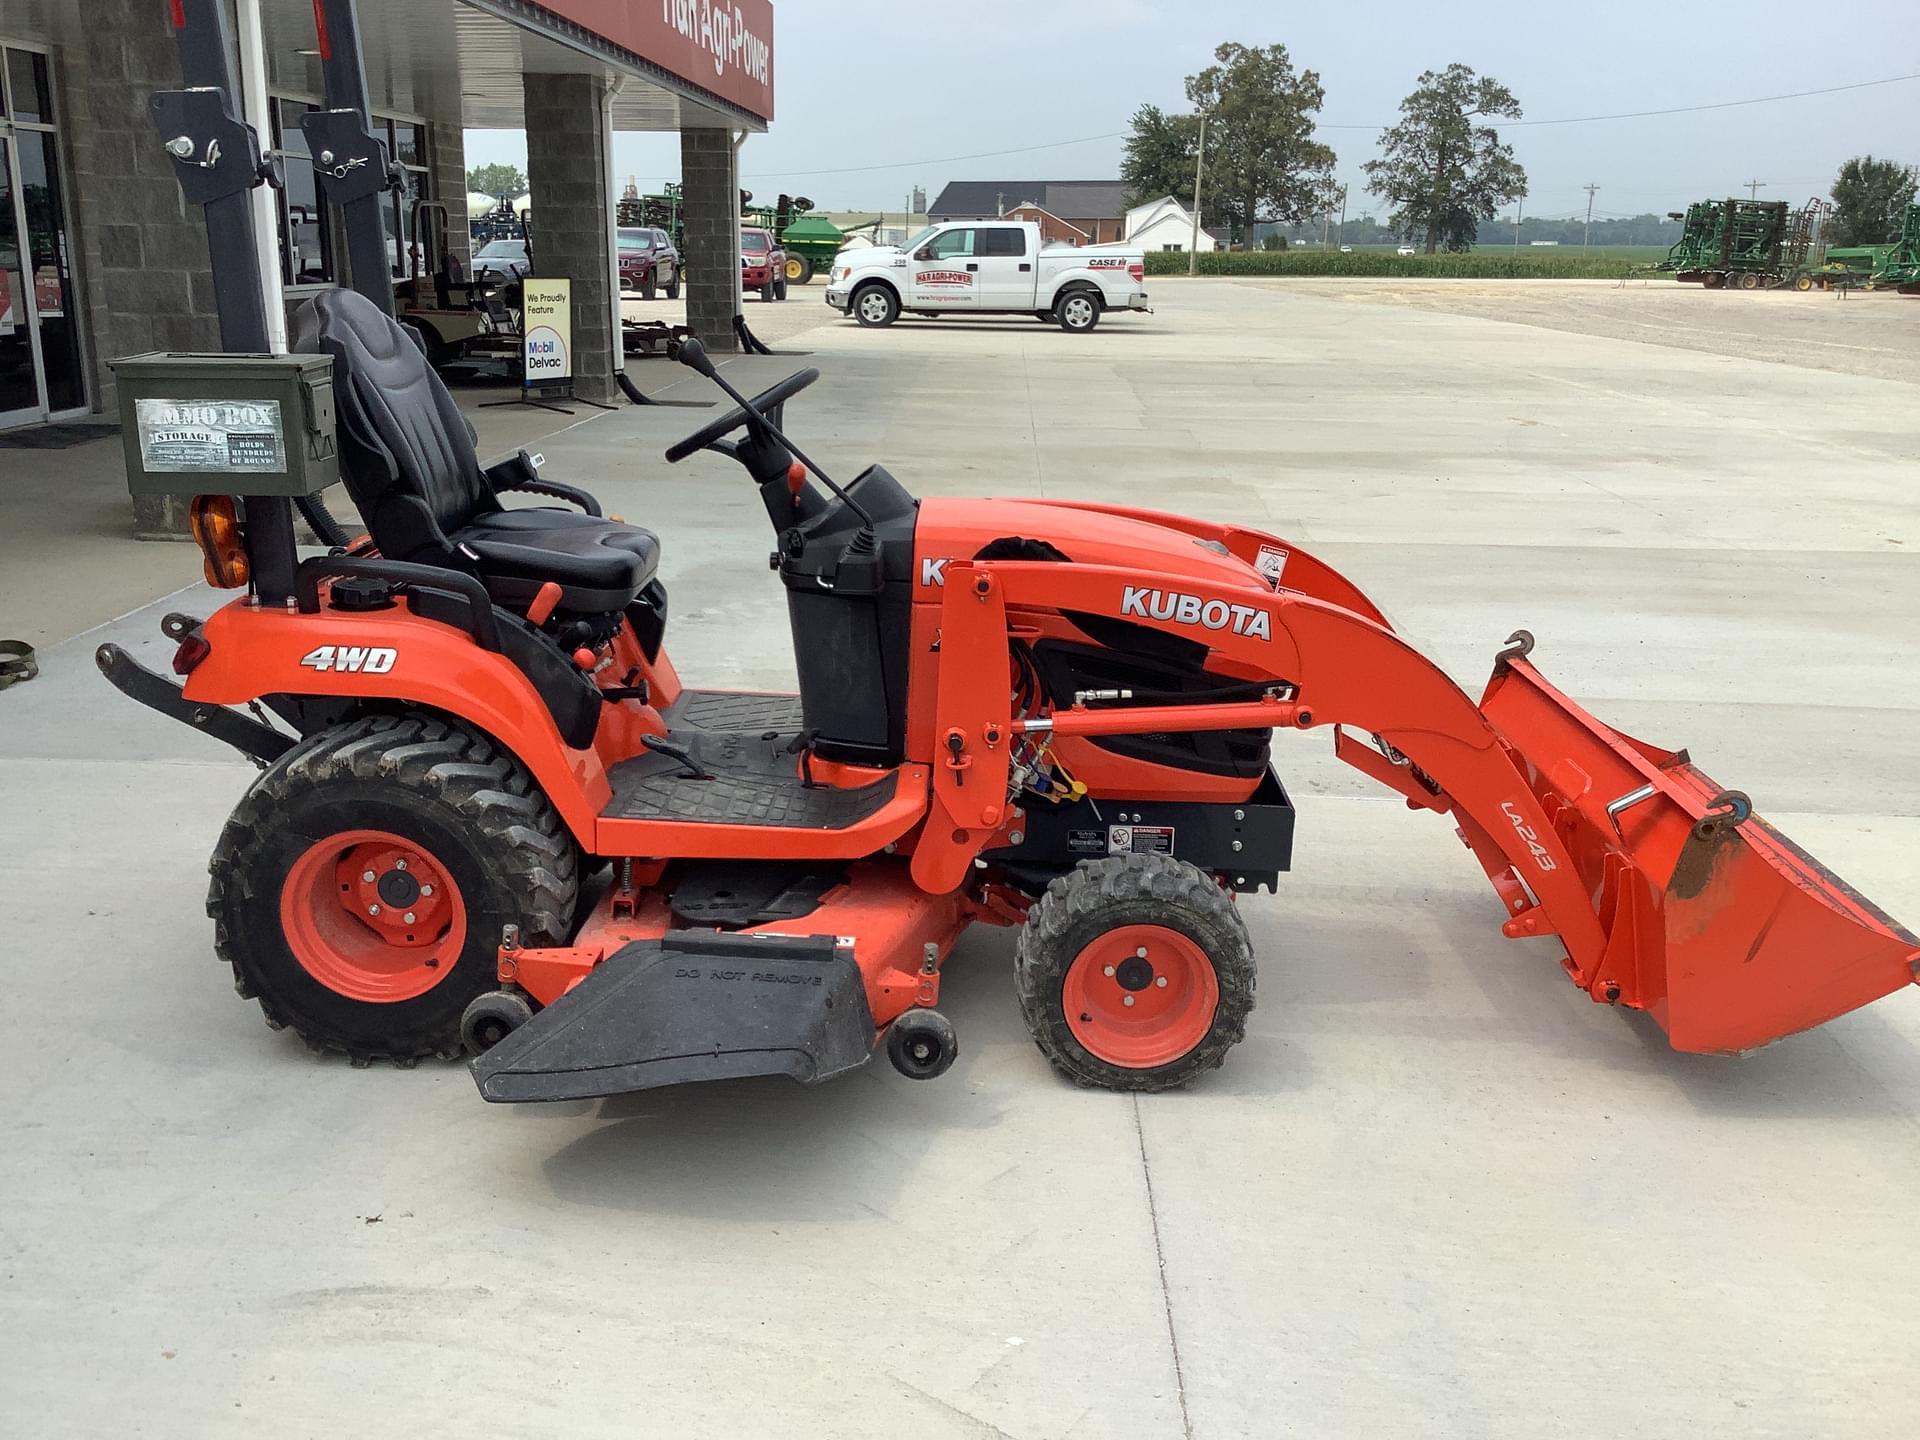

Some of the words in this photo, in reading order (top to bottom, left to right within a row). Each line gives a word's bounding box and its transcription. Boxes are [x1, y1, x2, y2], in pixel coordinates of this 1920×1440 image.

[701, 0, 769, 87] Agri-Power
[931, 271, 972, 282] AGRI-POWER
[527, 294, 538, 303] We
[540, 293, 567, 304] Proudly
[527, 306, 554, 315] Feature
[528, 341, 554, 354] Mobil
[529, 356, 561, 369] Delvac
[223, 406, 273, 426] BOX
[157, 431, 212, 443] STORAGE
[239, 441, 265, 449] HOLDS
[231, 449, 274, 457] HUNDREDS
[244, 457, 276, 465] ROUNDS
[1120, 585, 1272, 642] KUBOTA
[300, 645, 399, 674] 4WD
[1501, 802, 1557, 872] LA243
[674, 969, 701, 980] DO
[710, 969, 746, 982] NOT
[751, 972, 823, 987] REMOVE
